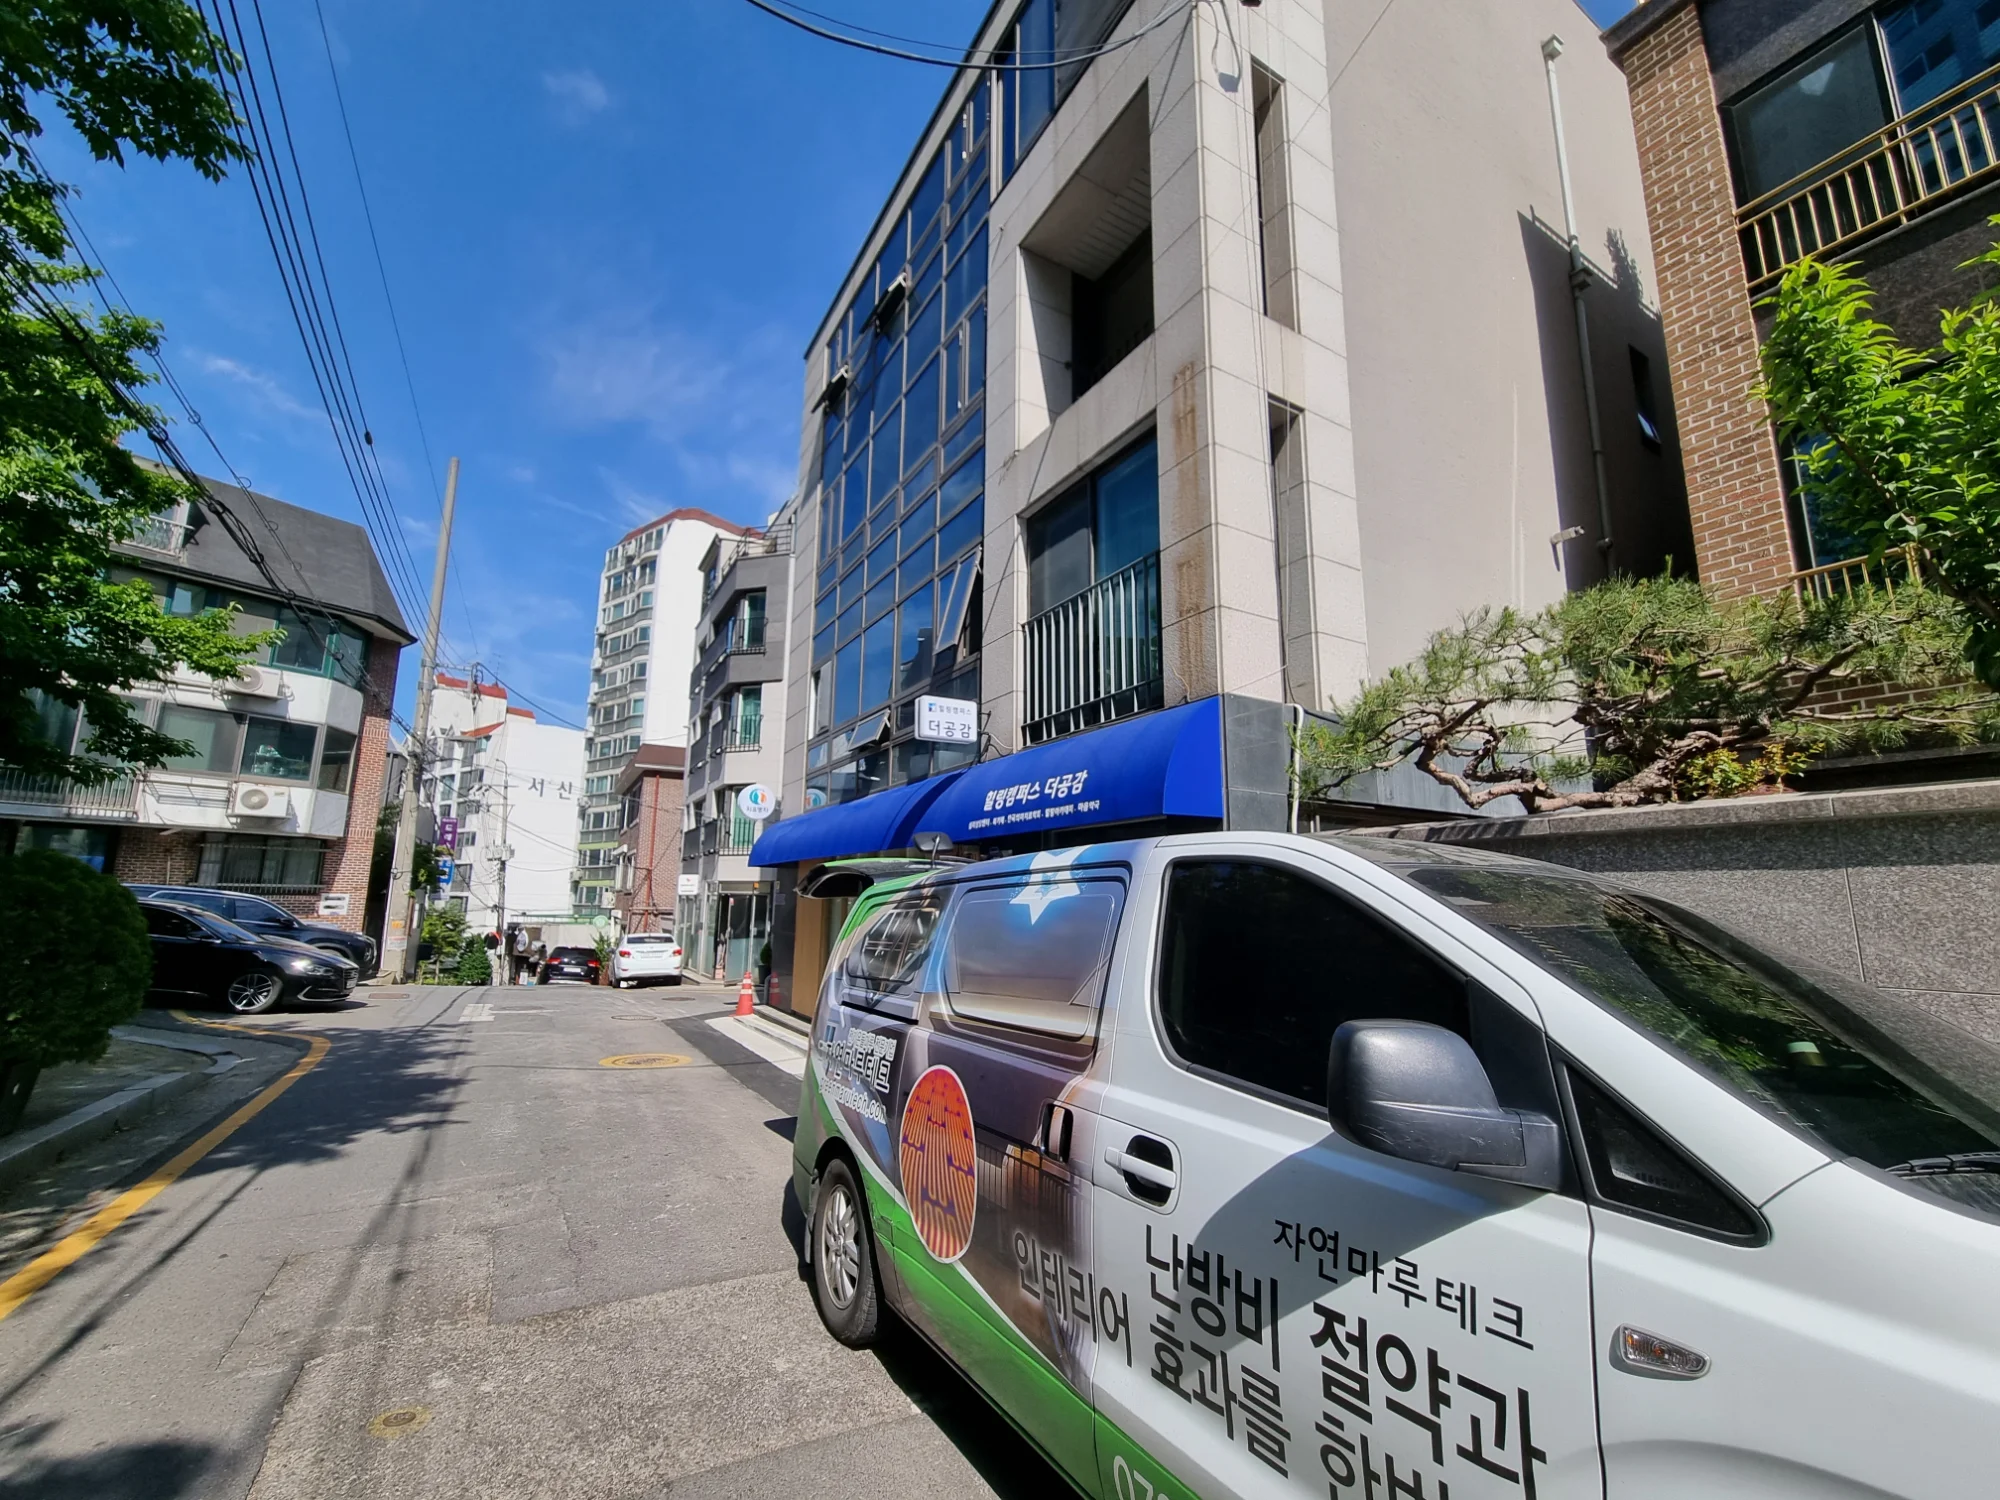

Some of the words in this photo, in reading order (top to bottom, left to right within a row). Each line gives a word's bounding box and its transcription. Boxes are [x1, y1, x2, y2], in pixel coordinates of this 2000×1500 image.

[928, 720, 972, 739] 더공감
[527, 777, 572, 800] 서신
[983, 781, 1041, 812] 힐링캠퍼스
[1044, 769, 1088, 799] 더공감
[1273, 1219, 1534, 1351] 자연마루테크
[1014, 1231, 1133, 1369] 인테리어
[1149, 1313, 1291, 1480] 효과를
[1145, 1223, 1280, 1374] 난방비
[1309, 1301, 1547, 1500] 절약과
